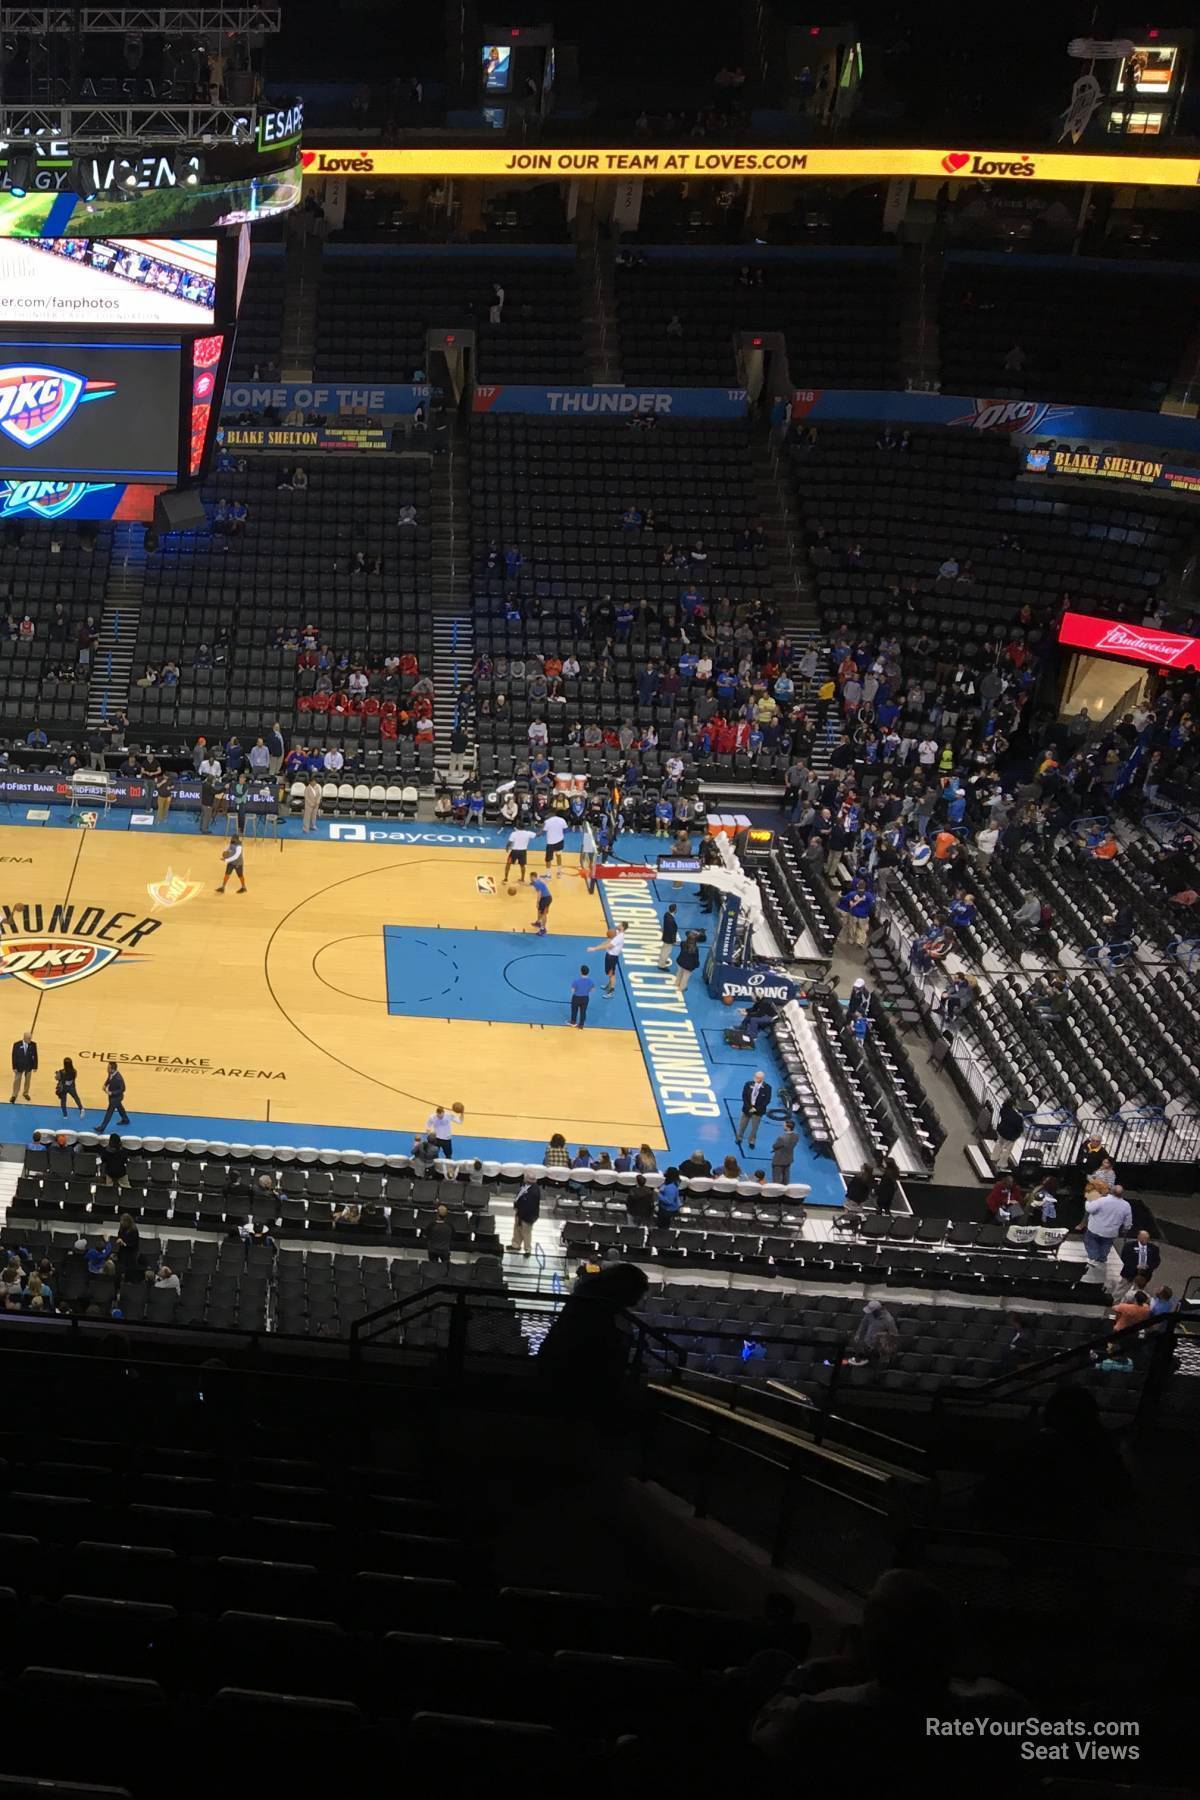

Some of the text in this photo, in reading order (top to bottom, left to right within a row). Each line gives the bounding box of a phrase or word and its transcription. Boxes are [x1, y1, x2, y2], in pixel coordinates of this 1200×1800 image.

[505, 154, 807, 170] JOIN OUR TEAM AT LOVES.COM
[295, 388, 330, 408] OF
[336, 390, 385, 409] THE
[477, 388, 495, 398] 117
[728, 390, 747, 401] 117
[795, 390, 815, 402] 118
[547, 392, 673, 413] THUNDER
[972, 402, 1035, 429] OKC
[227, 431, 265, 445] BLAKE
[268, 432, 318, 445] SHELTON
[1054, 452, 1099, 470] BLAKE
[1103, 456, 1163, 478] SHELTON
[1107, 630, 1181, 655] Budweiser
[369, 830, 487, 844] paycom
[628, 971, 688, 1014] CITY
[722, 983, 789, 1000] SPALDING
[78, 1050, 211, 1067] CHESAPEAKE
[155, 1066, 287, 1080] ENERGY ARENA
[641, 1019, 721, 1118] THUNDER
